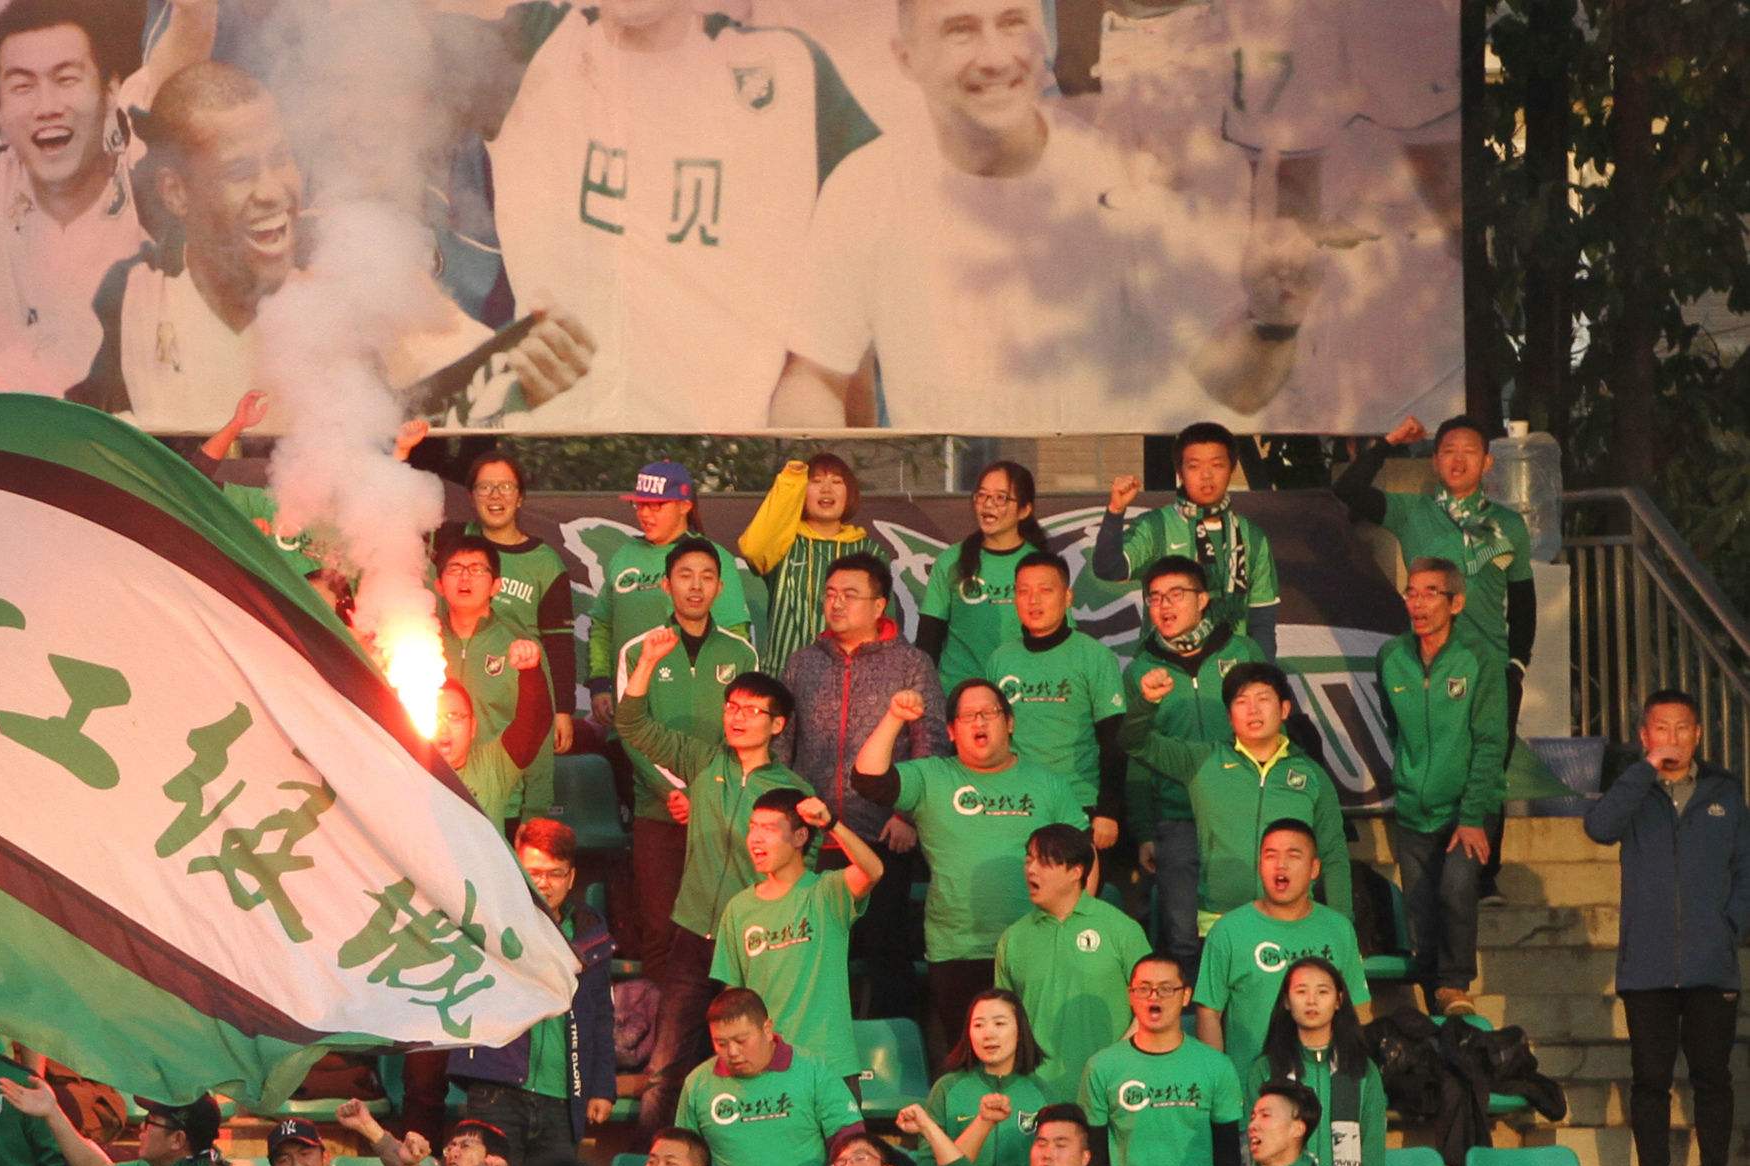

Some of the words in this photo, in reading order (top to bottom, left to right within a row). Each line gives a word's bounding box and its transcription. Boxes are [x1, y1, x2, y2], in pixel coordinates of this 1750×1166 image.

[501, 577, 534, 604] SOUL
[570, 1022, 578, 1049] THE
[571, 1052, 583, 1097] GLORY
